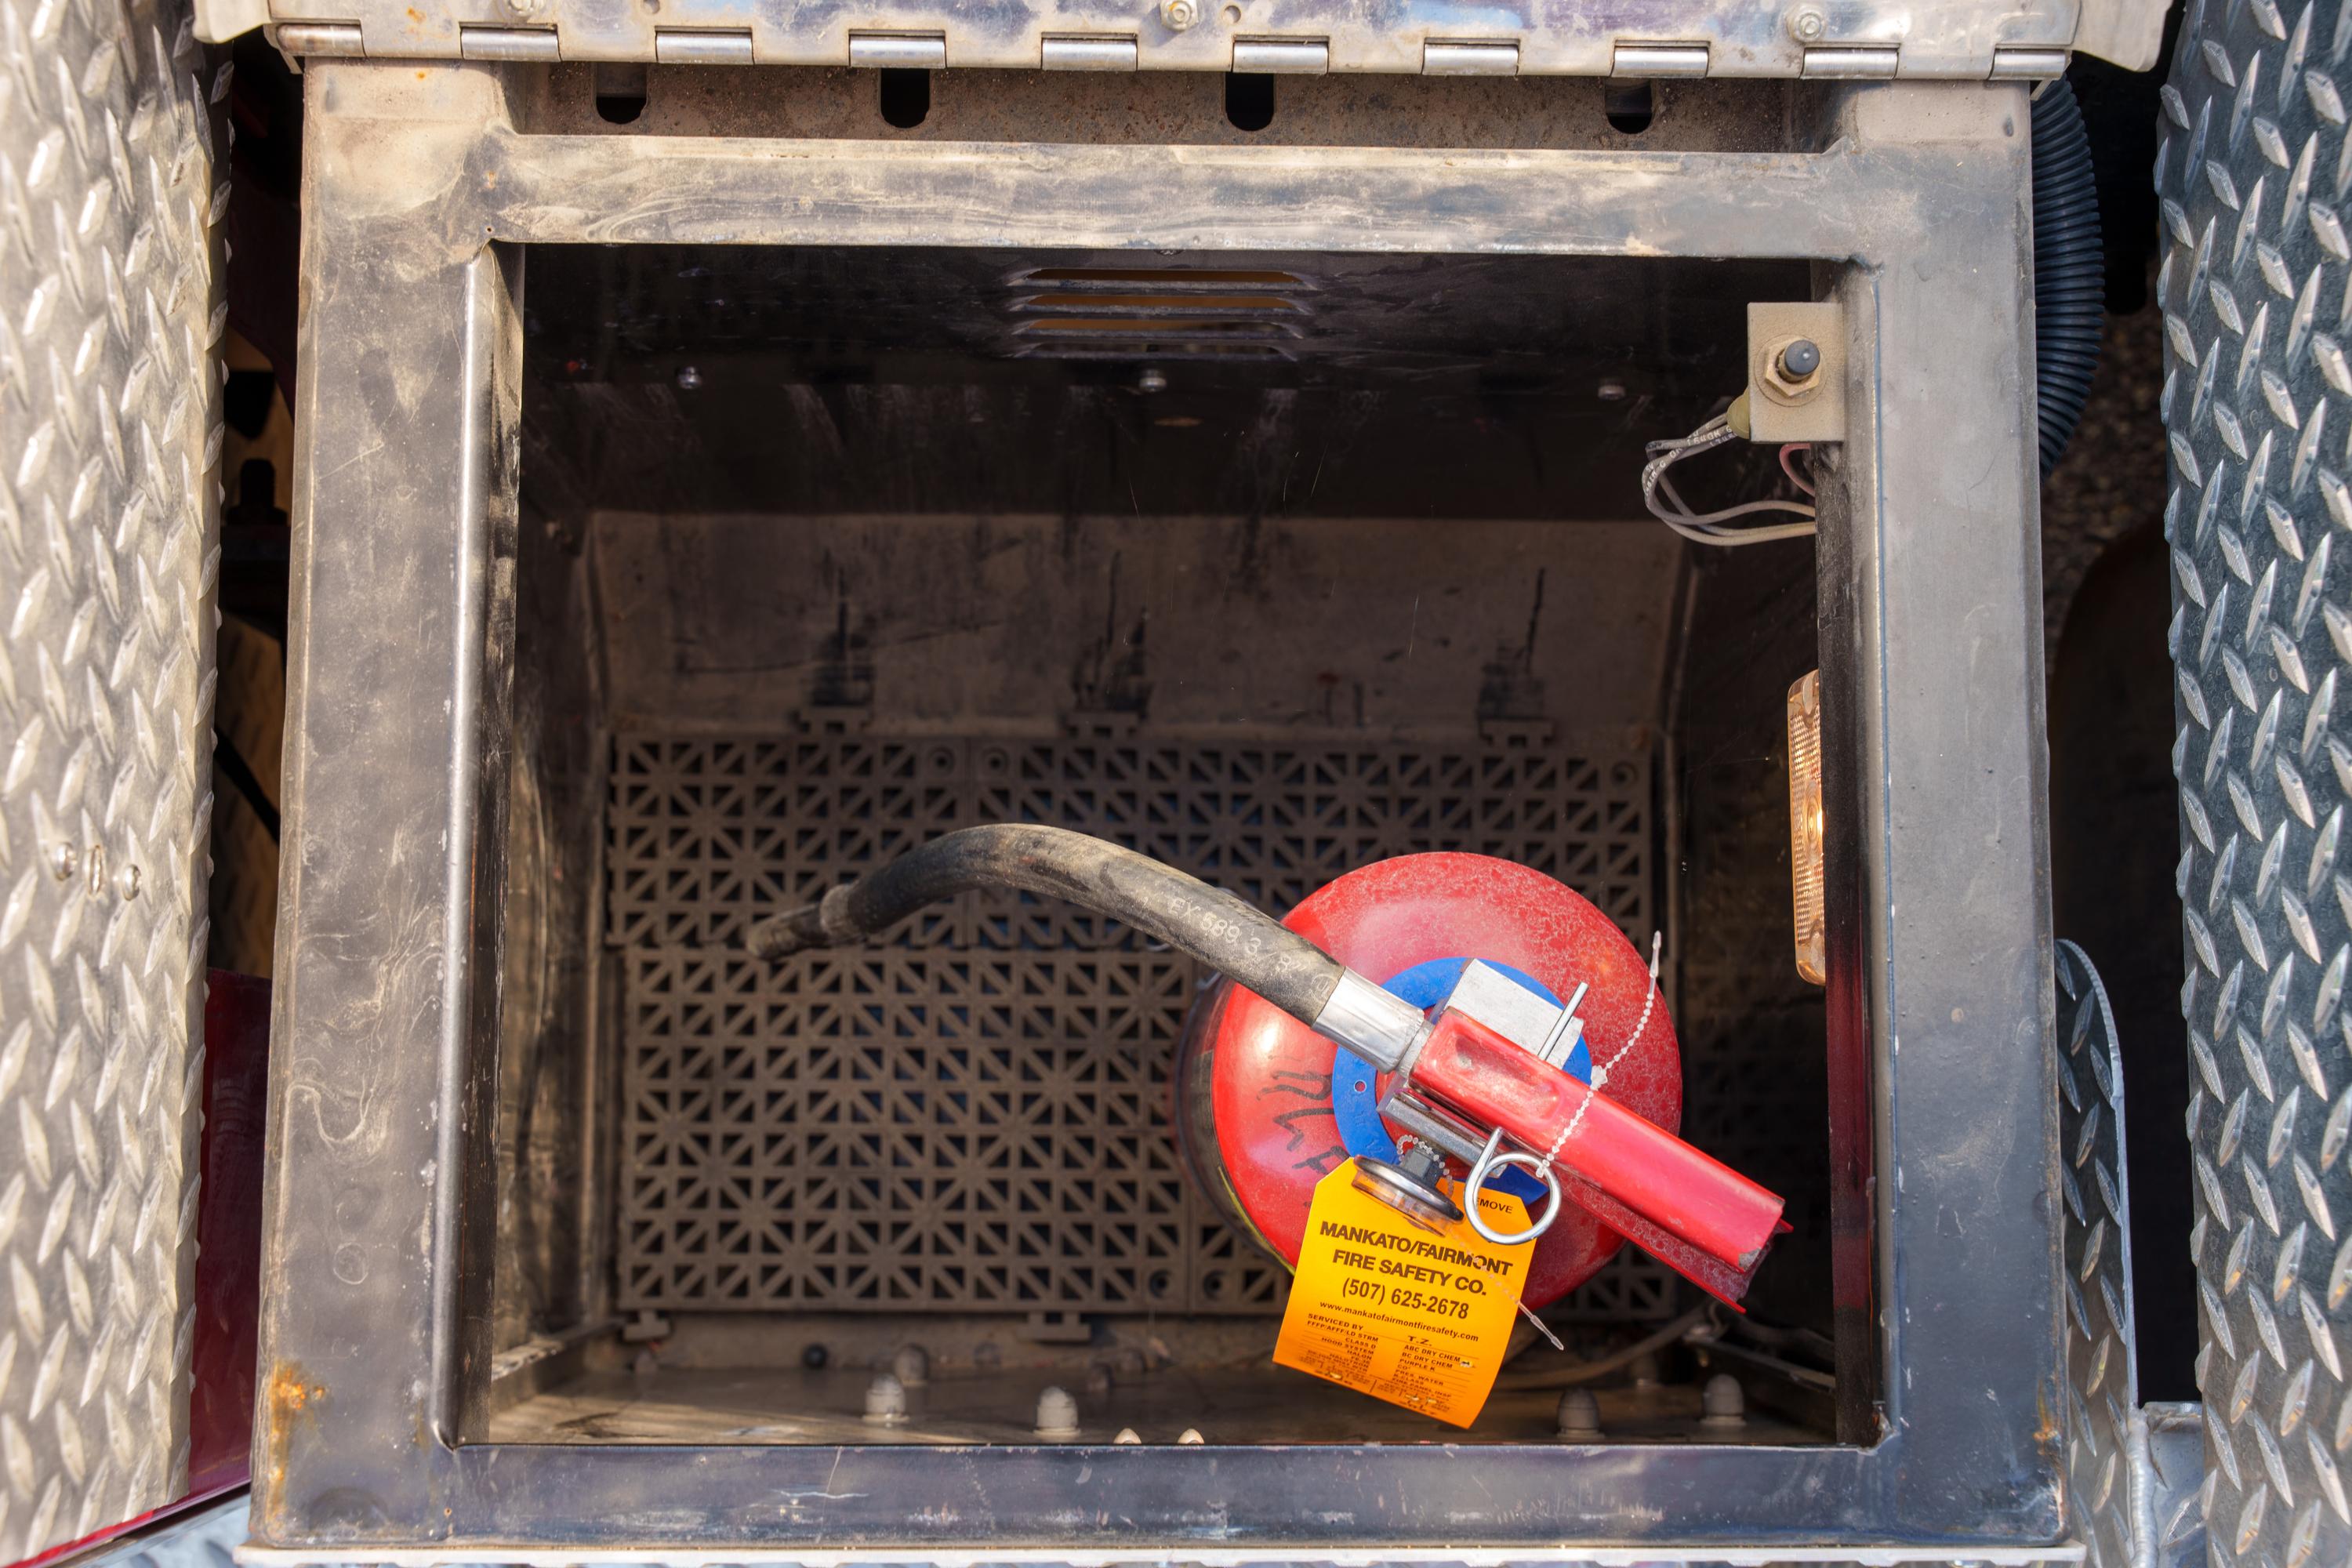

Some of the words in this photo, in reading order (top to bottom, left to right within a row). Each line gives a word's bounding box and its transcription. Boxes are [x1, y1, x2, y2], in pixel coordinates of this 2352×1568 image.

[1200, 911, 1241, 943] 589
[1319, 1221, 1513, 1276] MANKATO/FAIRMONT
[1332, 1249, 1376, 1271] FIRE
[1379, 1259, 1452, 1287] SAFETY
[1454, 1276, 1487, 1296] CO.
[1342, 1277, 1386, 1305] (507)
[1391, 1288, 1469, 1320] 625-2678
[1308, 1312, 1349, 1327] SERVICED
[1319, 1301, 1479, 1342] www.mankatofairmontfiresafety.com
[1345, 1337, 1370, 1347] CLASS
[1357, 1332, 1379, 1342] STRM
[1407, 1335, 1432, 1347] T.Z.
[1321, 1337, 1343, 1347] HOOD
[1345, 1343, 1374, 1355] SYSTEM
[1404, 1344, 1420, 1352] ABC
[1421, 1348, 1437, 1356] DRY
[1439, 1352, 1461, 1363] CHEM
[1347, 1350, 1372, 1360] HALON
[1414, 1355, 1429, 1363] DRY
[1431, 1359, 1453, 1369] CHEM
[1399, 1358, 1429, 1370] PURPLE
[1418, 1375, 1444, 1386] WATER
